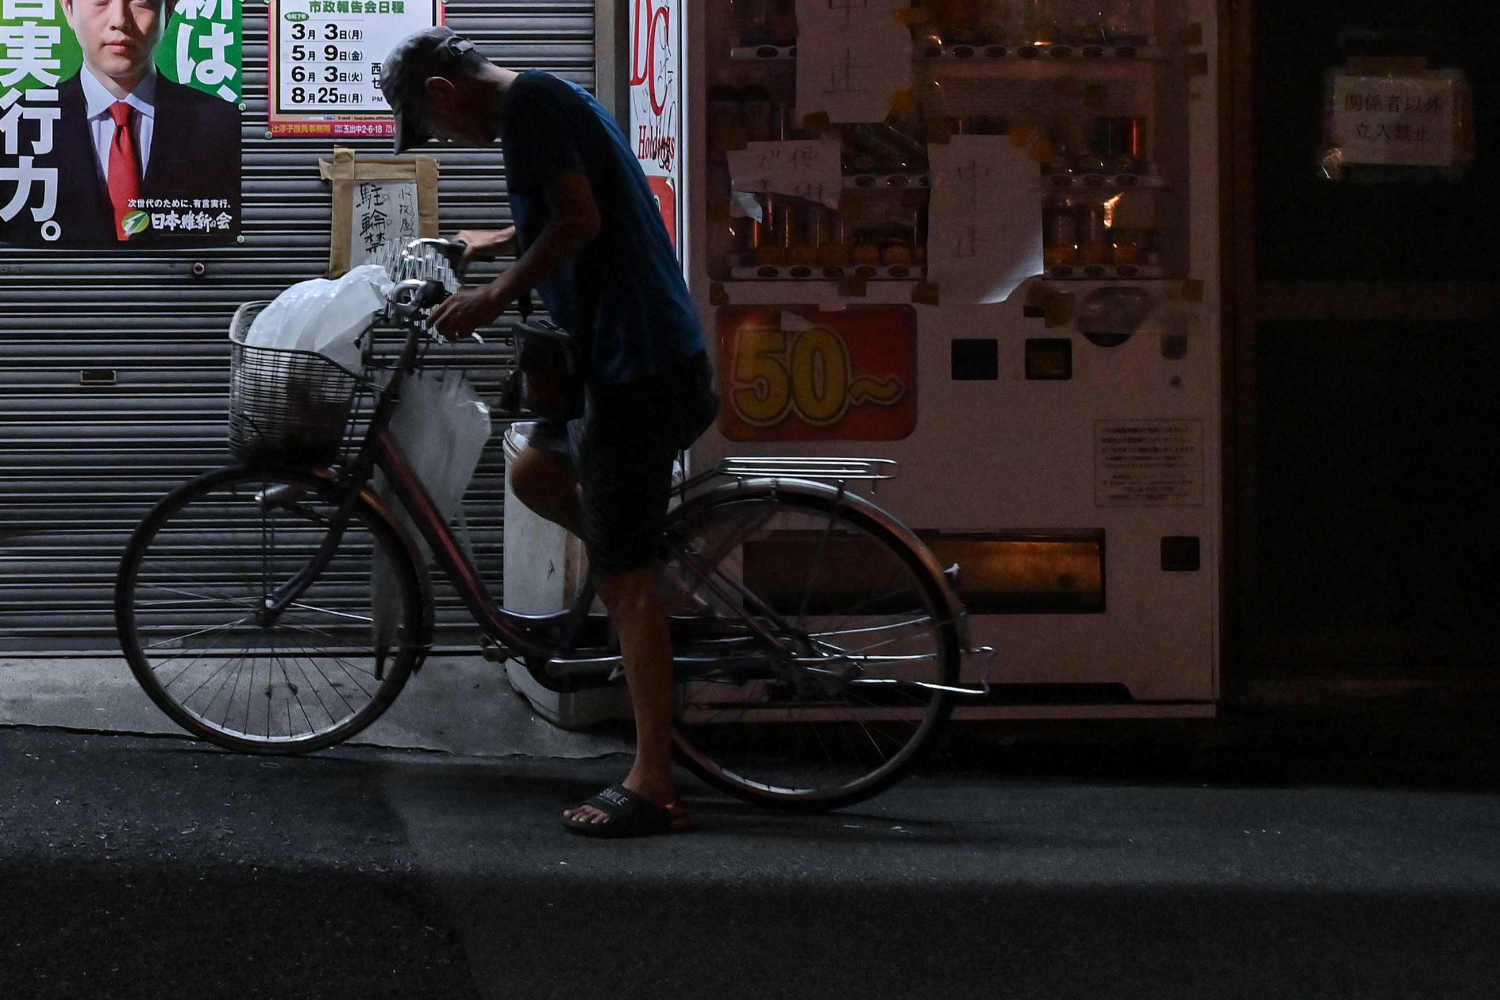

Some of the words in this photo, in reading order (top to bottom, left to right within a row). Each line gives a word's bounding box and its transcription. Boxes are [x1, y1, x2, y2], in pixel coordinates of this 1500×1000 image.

[308, 0, 405, 14] 市政報告会日程
[291, 87, 363, 104] 8月25日(月)
[1345, 93, 1443, 113] 関係者以外
[151, 210, 233, 232] 日本維新の会
